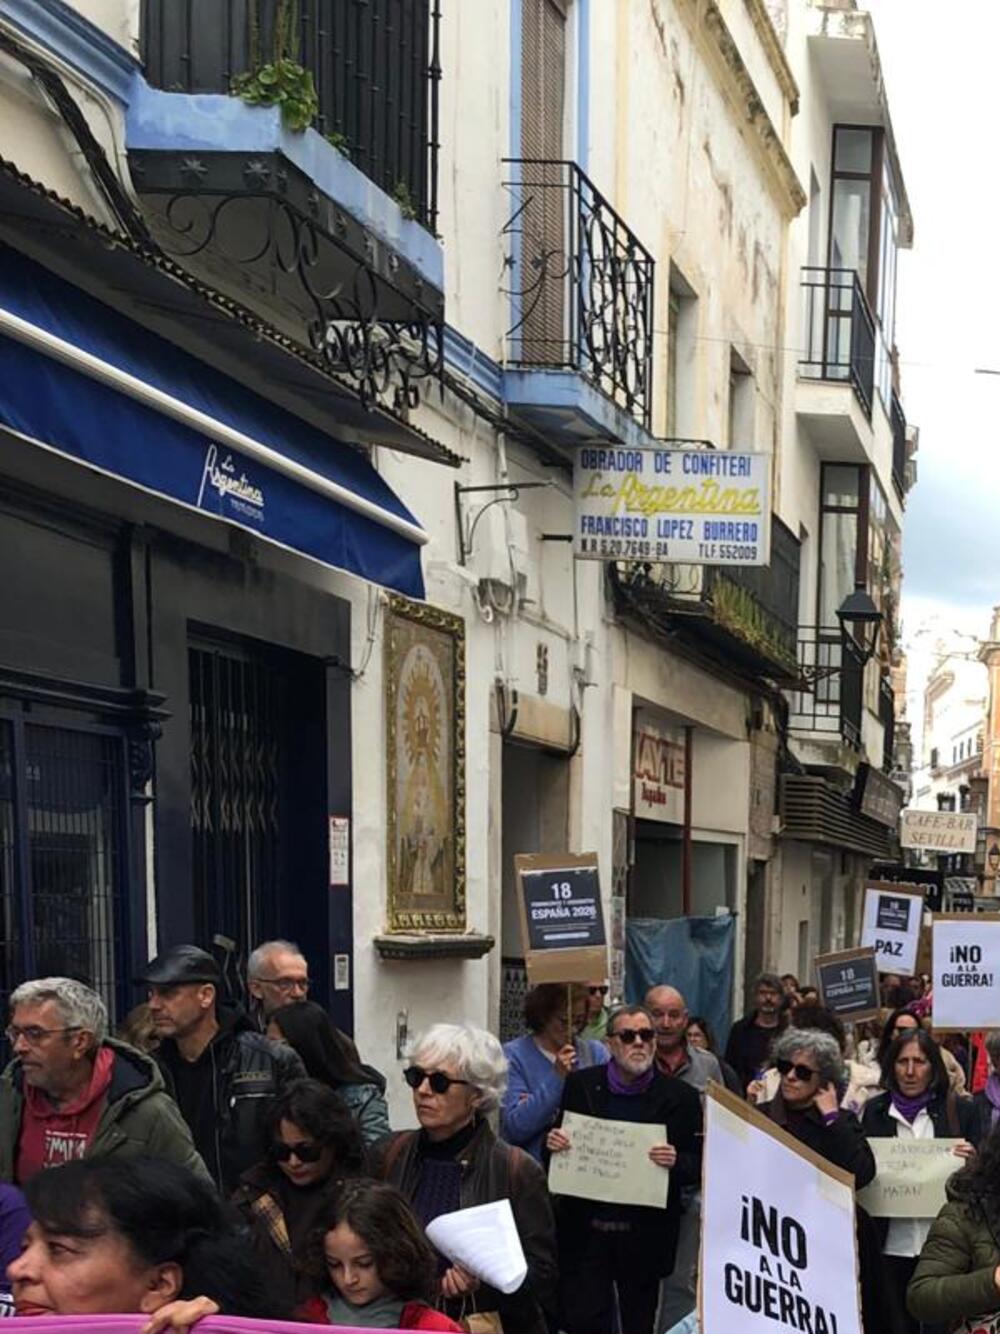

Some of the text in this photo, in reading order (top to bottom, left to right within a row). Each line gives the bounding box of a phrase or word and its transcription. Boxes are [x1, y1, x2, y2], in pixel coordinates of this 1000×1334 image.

[581, 449, 643, 473] OBRADOR
[654, 452, 671, 474] DE
[582, 473, 761, 516] La Argentina
[581, 515, 649, 538] FRANCISCO
[657, 518, 694, 540] LOPEZ
[911, 831, 966, 848] SEVILLA
[551, 882, 572, 899] 18
[531, 903, 571, 919] ESPAÑA
[875, 939, 904, 957] PAZ
[950, 945, 982, 964] ¡NO
[966, 965, 978, 973] LA
[941, 973, 993, 988] GUERRA!
[741, 1194, 807, 1270] ¡NO
[760, 1255, 803, 1292] A LA
